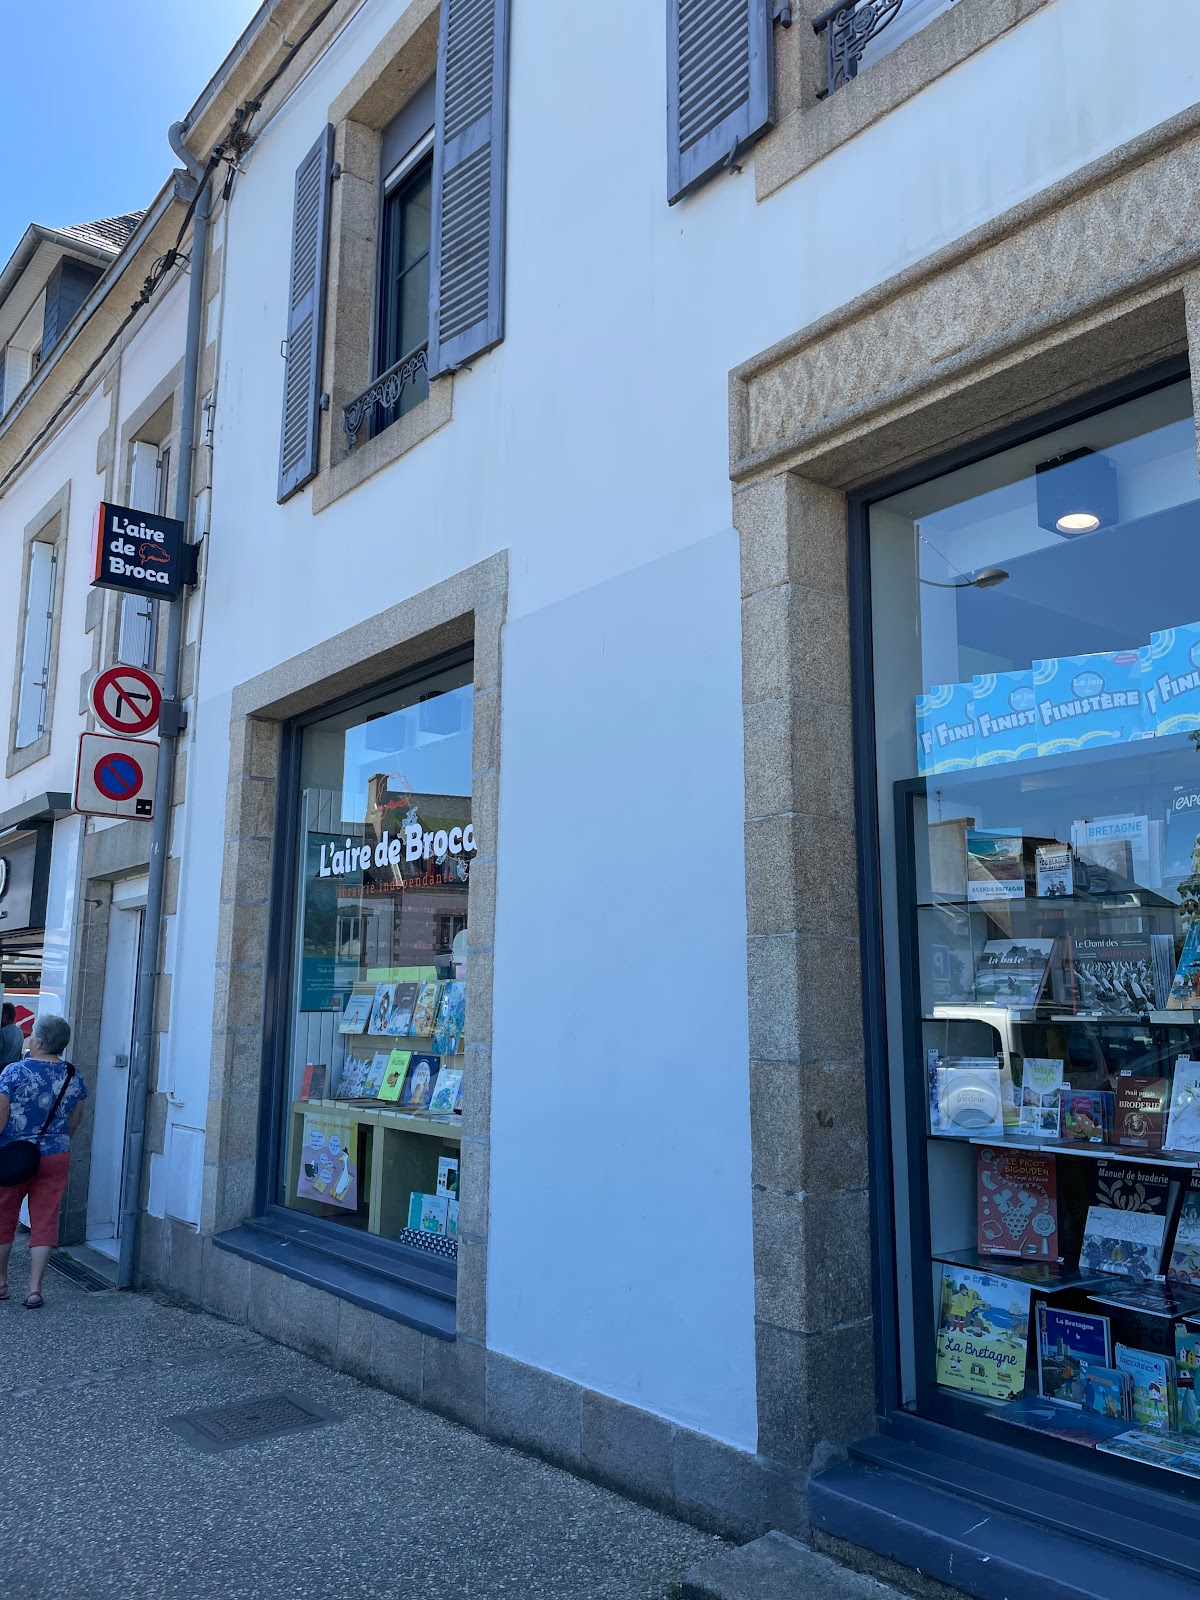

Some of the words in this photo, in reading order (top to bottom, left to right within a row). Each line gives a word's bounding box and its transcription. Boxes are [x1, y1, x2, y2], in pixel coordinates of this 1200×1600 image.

[112, 516, 164, 543] L'aire
[110, 538, 135, 556] de
[109, 556, 170, 585] Broca
[1039, 690, 1139, 727] FINISTÈRE
[936, 722, 975, 747] FINI
[1088, 821, 1143, 837] BRETAGNE
[319, 838, 371, 878] L'aire
[374, 830, 401, 867] de
[1075, 940, 1083, 949] Le
[1084, 939, 1105, 948] Chant
[1106, 938, 1119, 947] des
[1119, 1100, 1161, 1109] BRODERIE
[1004, 1165, 1049, 1176] BIGOUDEN
[1006, 1157, 1017, 1166] LE
[1019, 1158, 1047, 1167] PICOT
[1098, 1167, 1125, 1179] Manuel
[1126, 1170, 1136, 1180] de
[1137, 1171, 1169, 1184] broderie
[1055, 1317, 1064, 1325] La
[1064, 1319, 1095, 1331] Bretagne
[944, 1337, 963, 1353] La
[964, 1341, 1018, 1368] Bretagne
